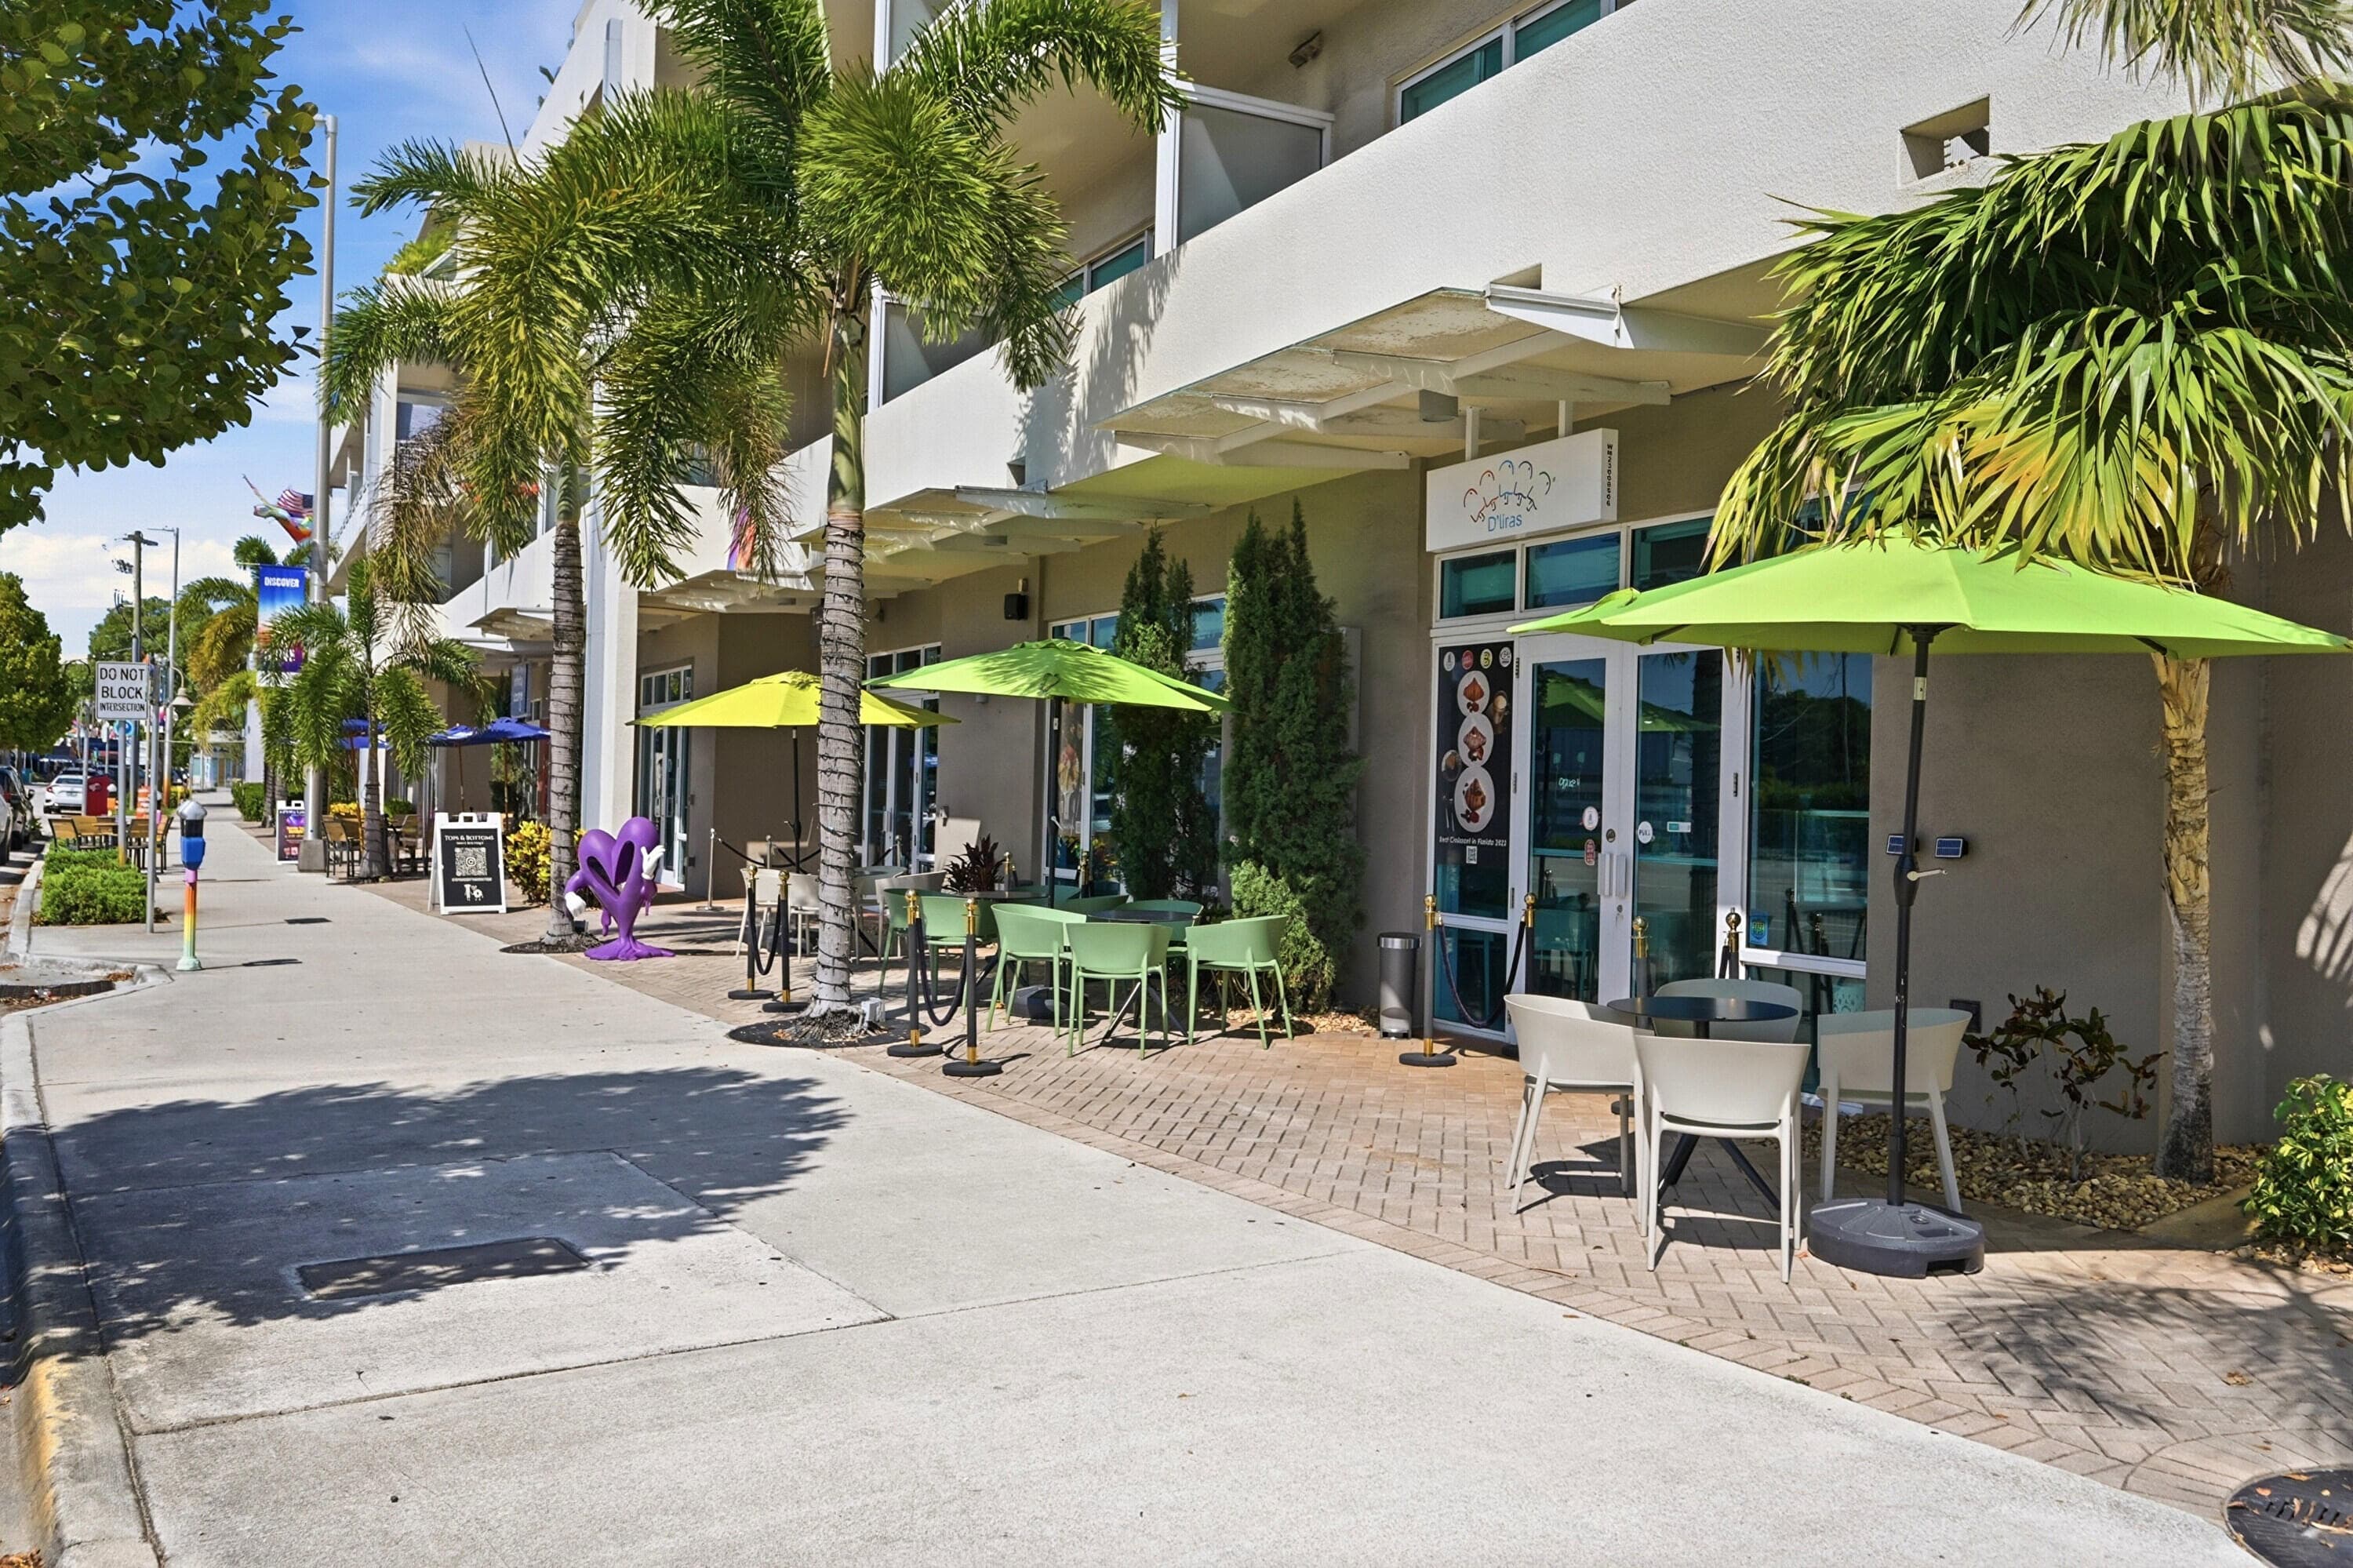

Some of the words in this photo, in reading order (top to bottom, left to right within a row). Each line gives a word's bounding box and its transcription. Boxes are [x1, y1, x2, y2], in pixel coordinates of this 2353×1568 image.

[1488, 514, 1522, 532] D'liras
[264, 577, 300, 588] DISCOVER
[100, 668, 117, 680] DO
[120, 668, 144, 681] NOT
[101, 686, 143, 699] BLOCK
[100, 702, 144, 711] INTERSECTION
